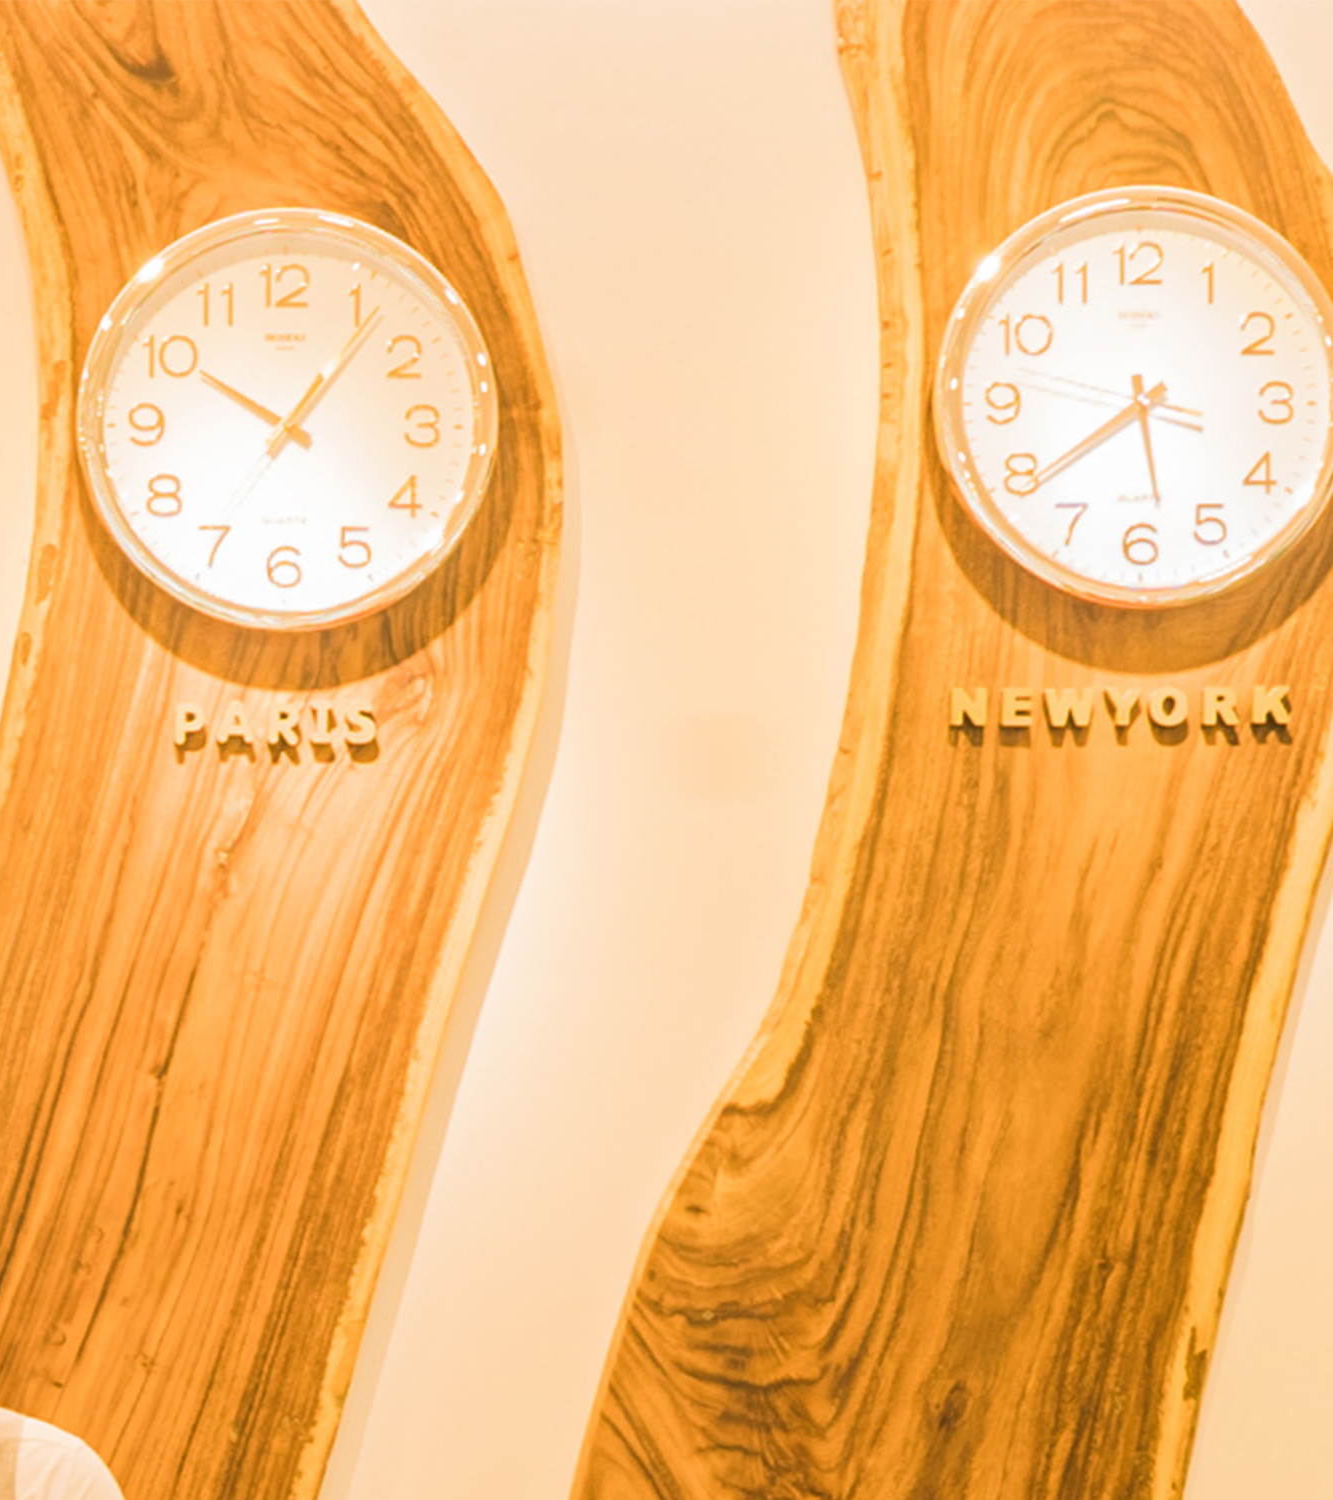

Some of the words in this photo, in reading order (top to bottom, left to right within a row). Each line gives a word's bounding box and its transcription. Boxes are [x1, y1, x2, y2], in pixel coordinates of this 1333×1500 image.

[1052, 263, 1088, 304] 11
[1113, 242, 1164, 285] 12
[1201, 262, 1215, 304] 1
[197, 283, 234, 326] 11
[260, 264, 311, 308] 12
[349, 283, 363, 326] 1
[999, 315, 1053, 356] 10
[1241, 313, 1276, 355] 2
[142, 336, 198, 378] 10
[386, 336, 422, 379] 2
[985, 382, 1021, 424] 9
[1259, 382, 1294, 424] 3
[128, 404, 165, 446] 9
[404, 405, 440, 448] 3
[1005, 453, 1039, 496] 8
[1243, 452, 1277, 493] 4
[147, 474, 182, 516] 8
[388, 474, 423, 518] 4
[1055, 504, 1087, 546] 7
[1123, 522, 1158, 565] 6
[1194, 504, 1227, 545] 5
[198, 526, 231, 568] 7
[266, 546, 302, 587] 6
[338, 526, 371, 568] 5
[175, 702, 378, 745] PARIS
[950, 685, 1293, 727] NEWYORK
